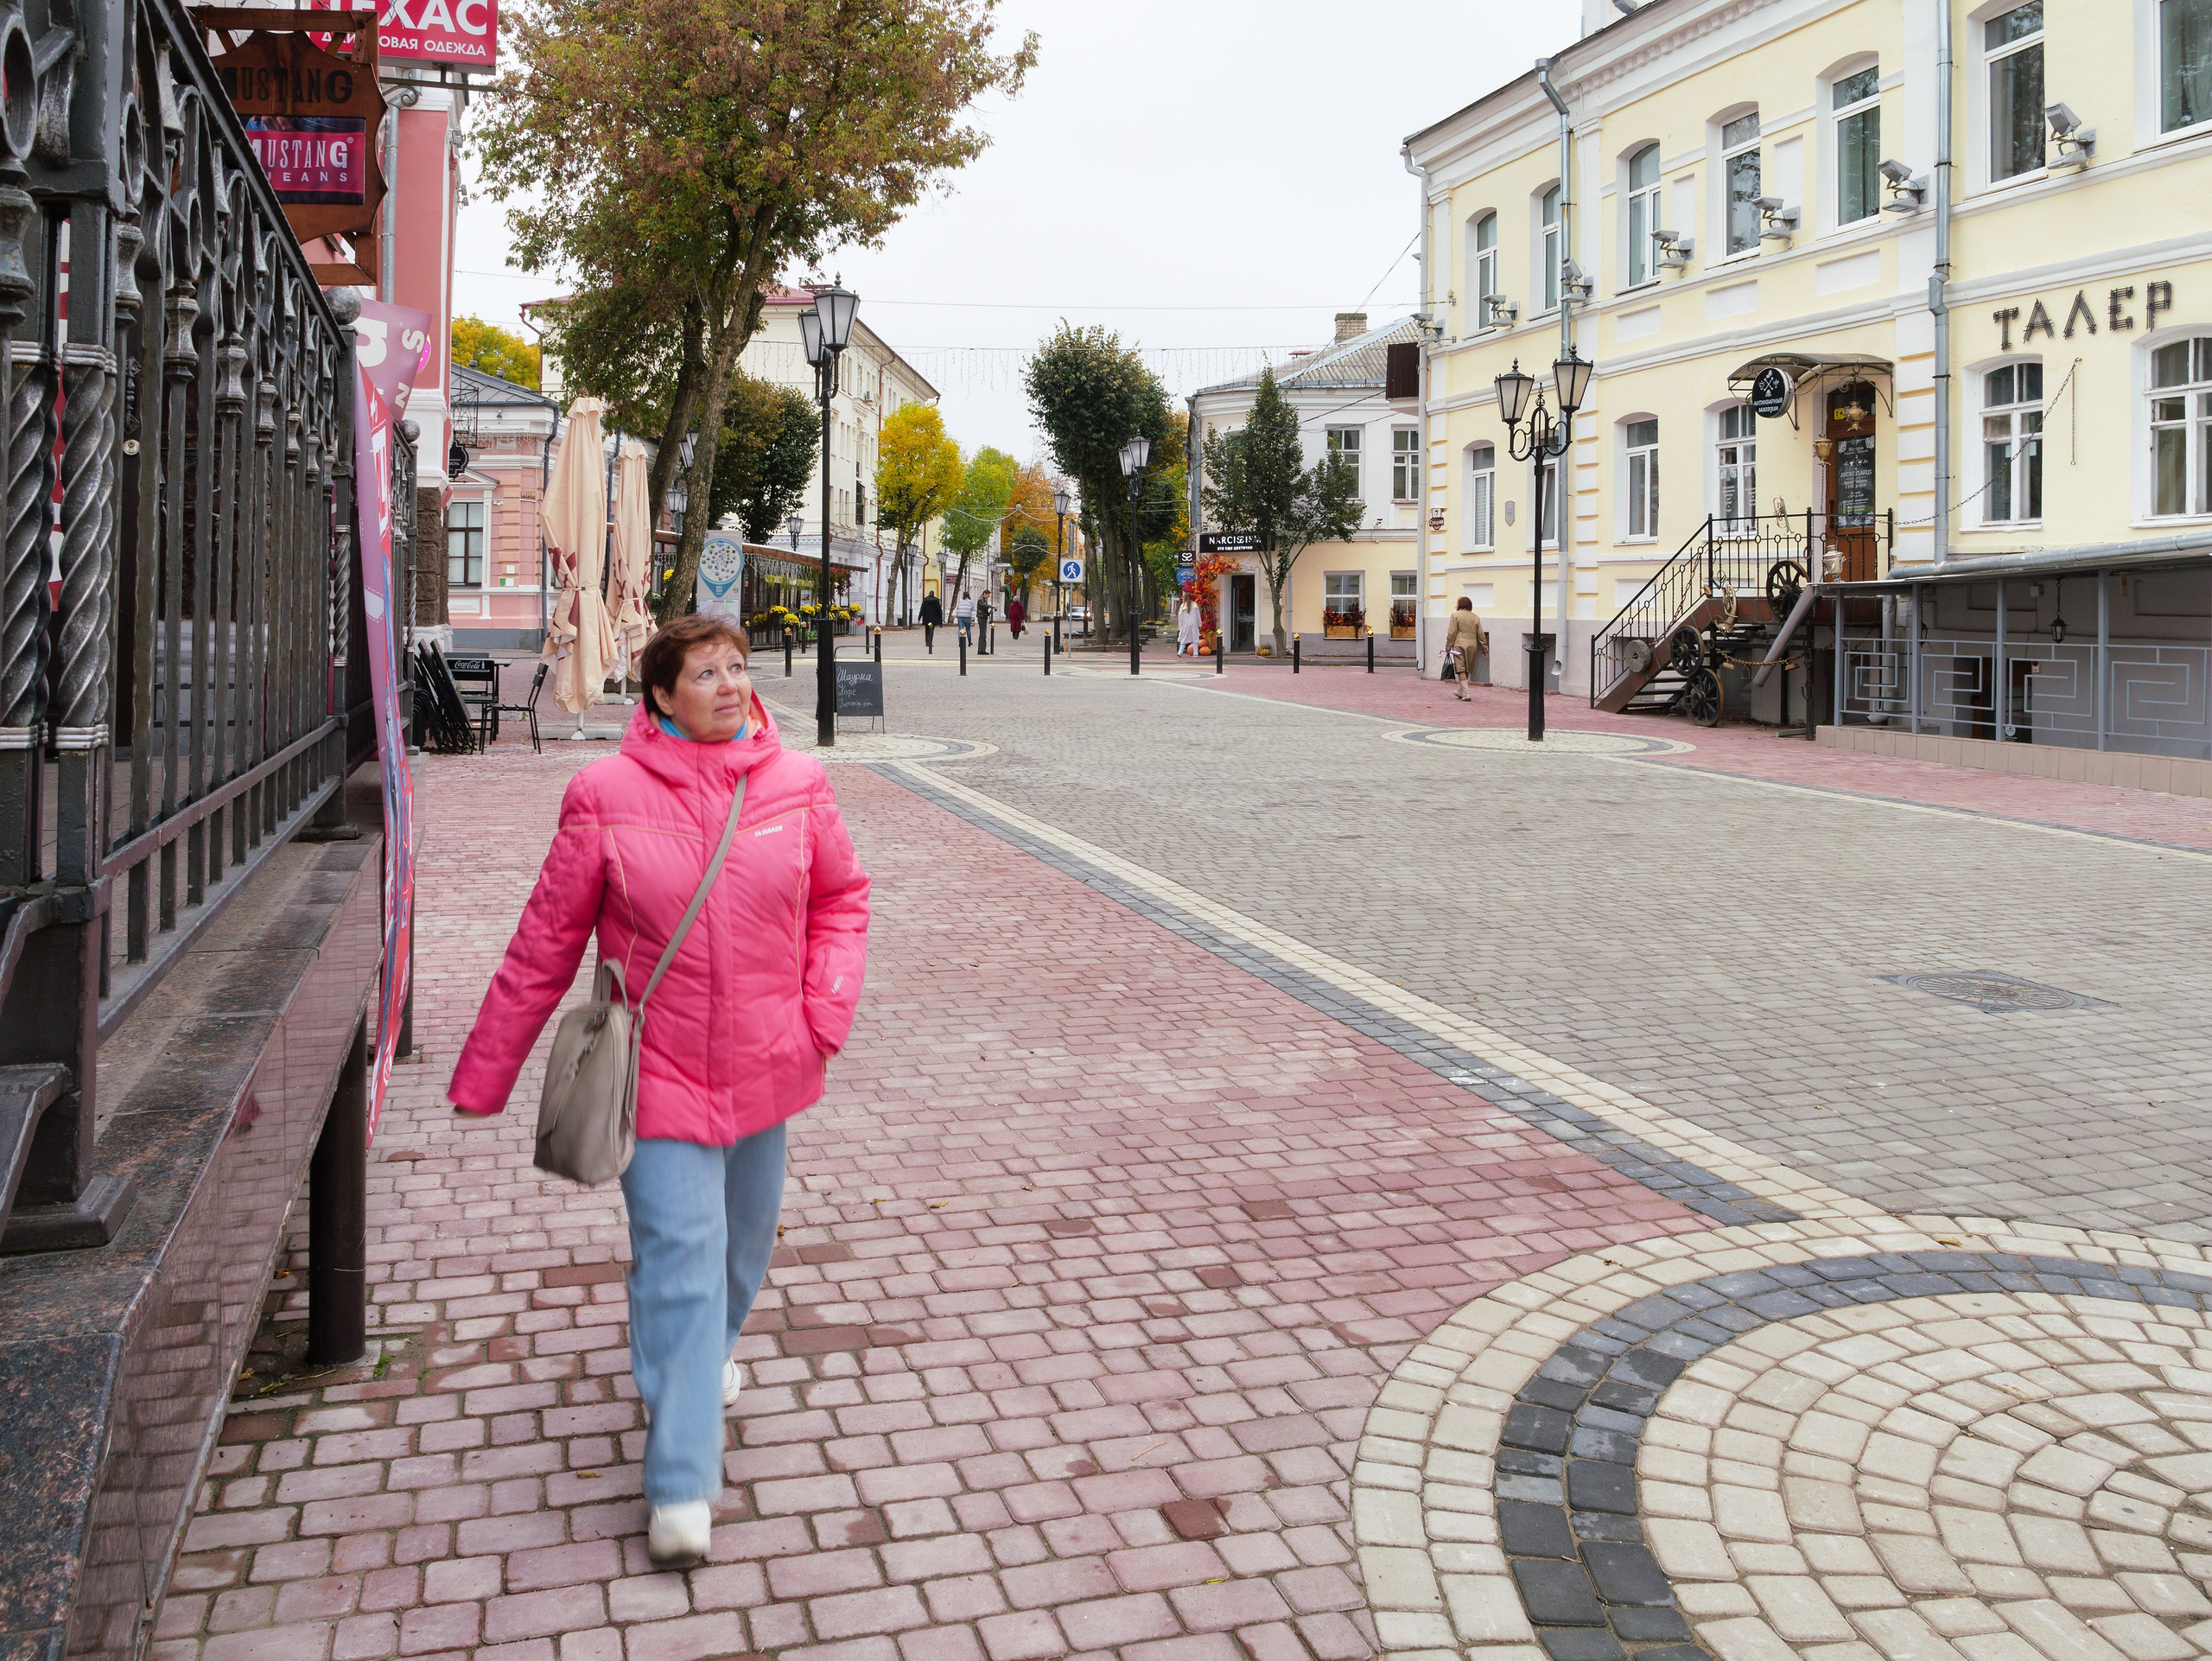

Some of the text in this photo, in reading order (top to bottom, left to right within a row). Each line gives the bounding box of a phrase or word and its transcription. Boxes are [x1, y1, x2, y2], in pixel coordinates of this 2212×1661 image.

[330, 0, 487, 35] ХАС
[424, 40, 486, 56] ОДЕЖДА
[1993, 280, 2172, 351] ТАЛЕР
[836, 666, 874, 685] Шаурма
